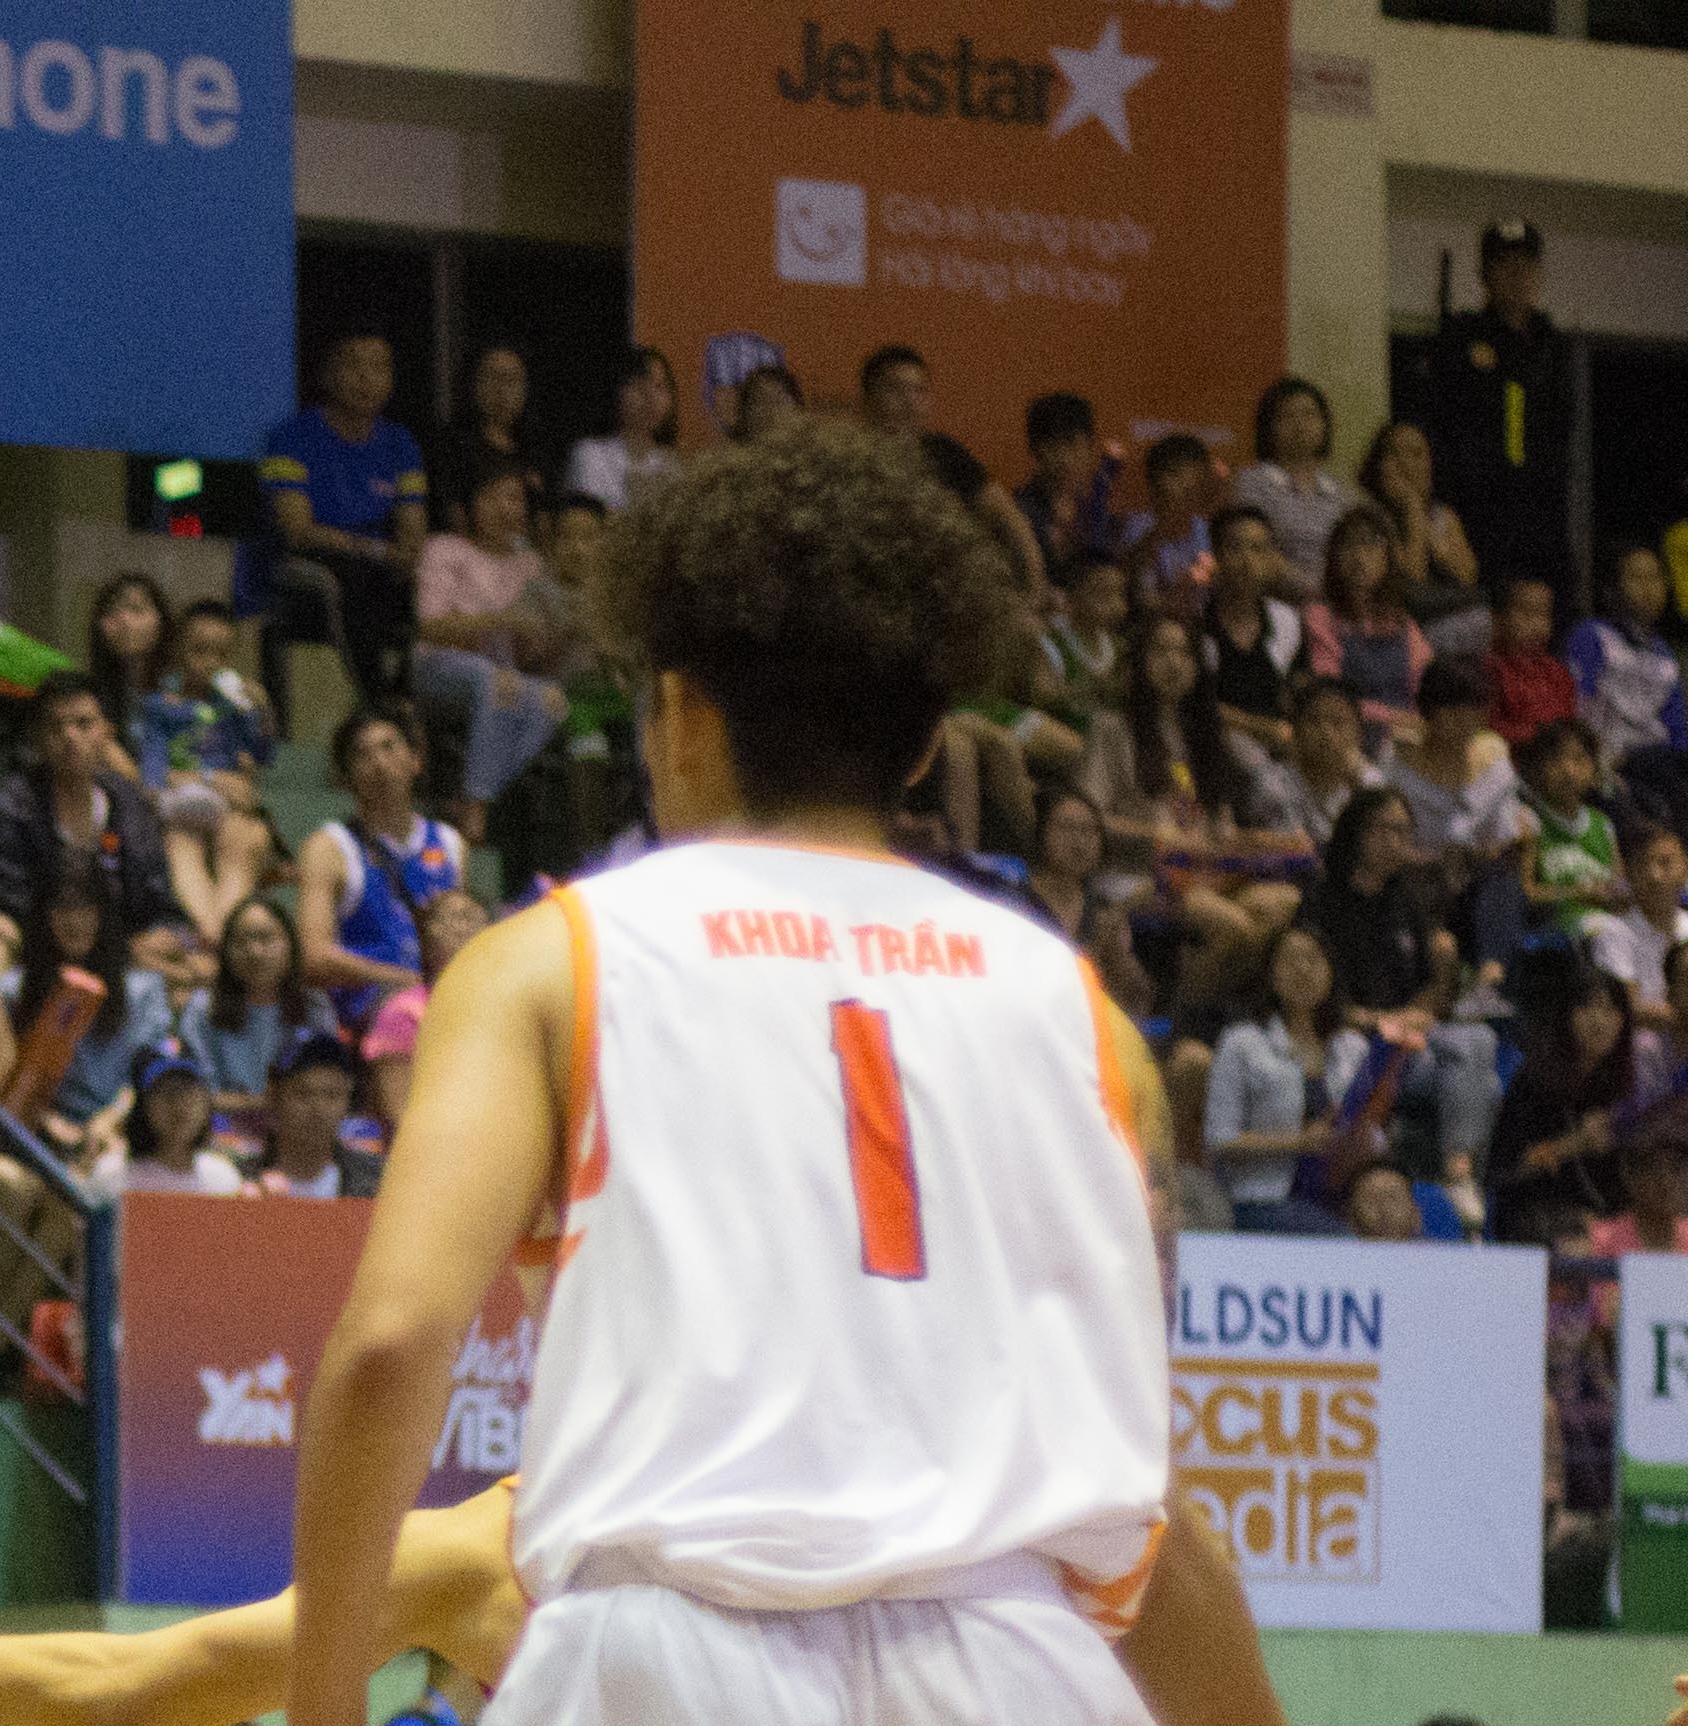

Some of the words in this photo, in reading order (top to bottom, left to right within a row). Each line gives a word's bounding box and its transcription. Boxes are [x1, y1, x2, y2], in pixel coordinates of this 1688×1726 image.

[775, 20, 1057, 127] Jetstar
[700, 909, 841, 962] KHOA
[828, 998, 928, 1282] 1
